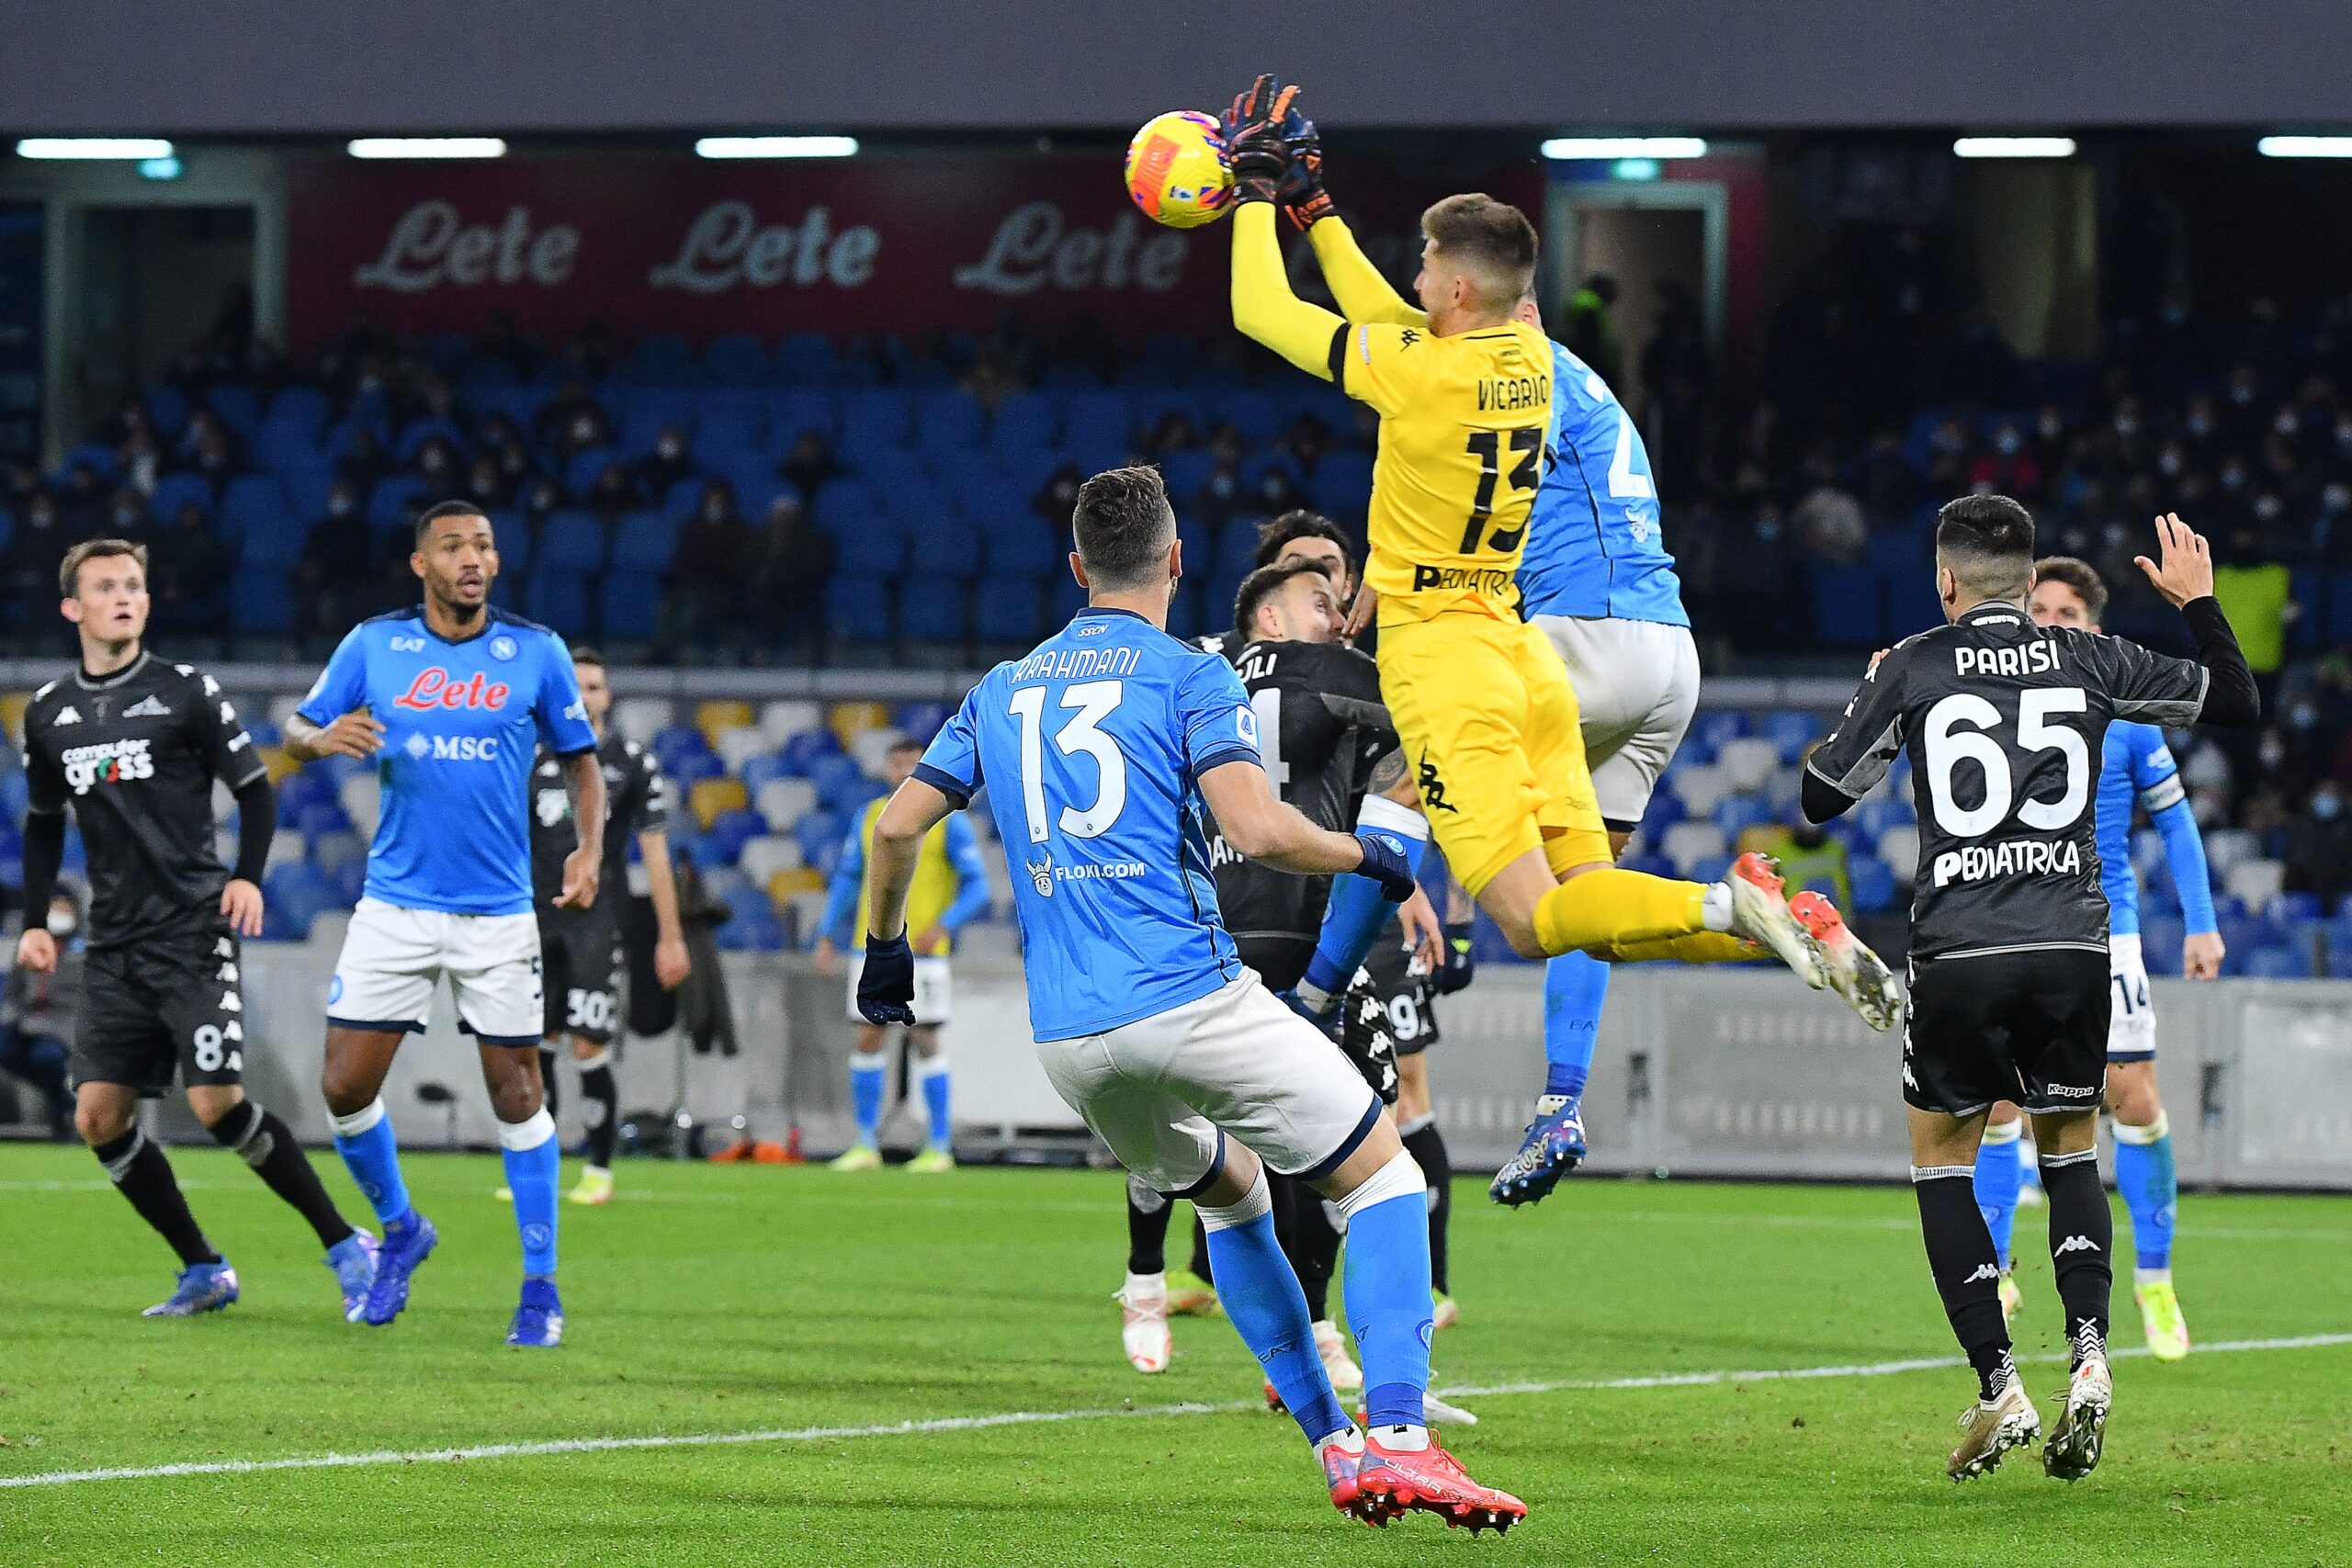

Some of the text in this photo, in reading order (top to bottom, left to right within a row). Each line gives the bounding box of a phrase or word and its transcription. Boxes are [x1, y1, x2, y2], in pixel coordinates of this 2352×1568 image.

[353, 199, 581, 294] Lete
[648, 199, 880, 294] Lete
[953, 200, 1191, 295] Lete
[1459, 427, 1543, 555] 13
[1077, 624, 1110, 638] SSCN
[1010, 647, 1142, 684] RRAHMANI
[1955, 640, 2061, 676] PARISI
[393, 666, 510, 711] Lete
[61, 738, 152, 764] computer
[433, 734, 498, 761] MSC
[1007, 679, 1127, 844] 13
[1924, 687, 2090, 838] 65
[64, 752, 156, 795] gross
[1054, 862, 1147, 882] FLOKI.COM
[1933, 840, 2081, 888] PEDIATRICA
[193, 1023, 224, 1072] 8
[2047, 1083, 2095, 1098] Kappa
[1384, 1457, 1444, 1495] ULTRA
